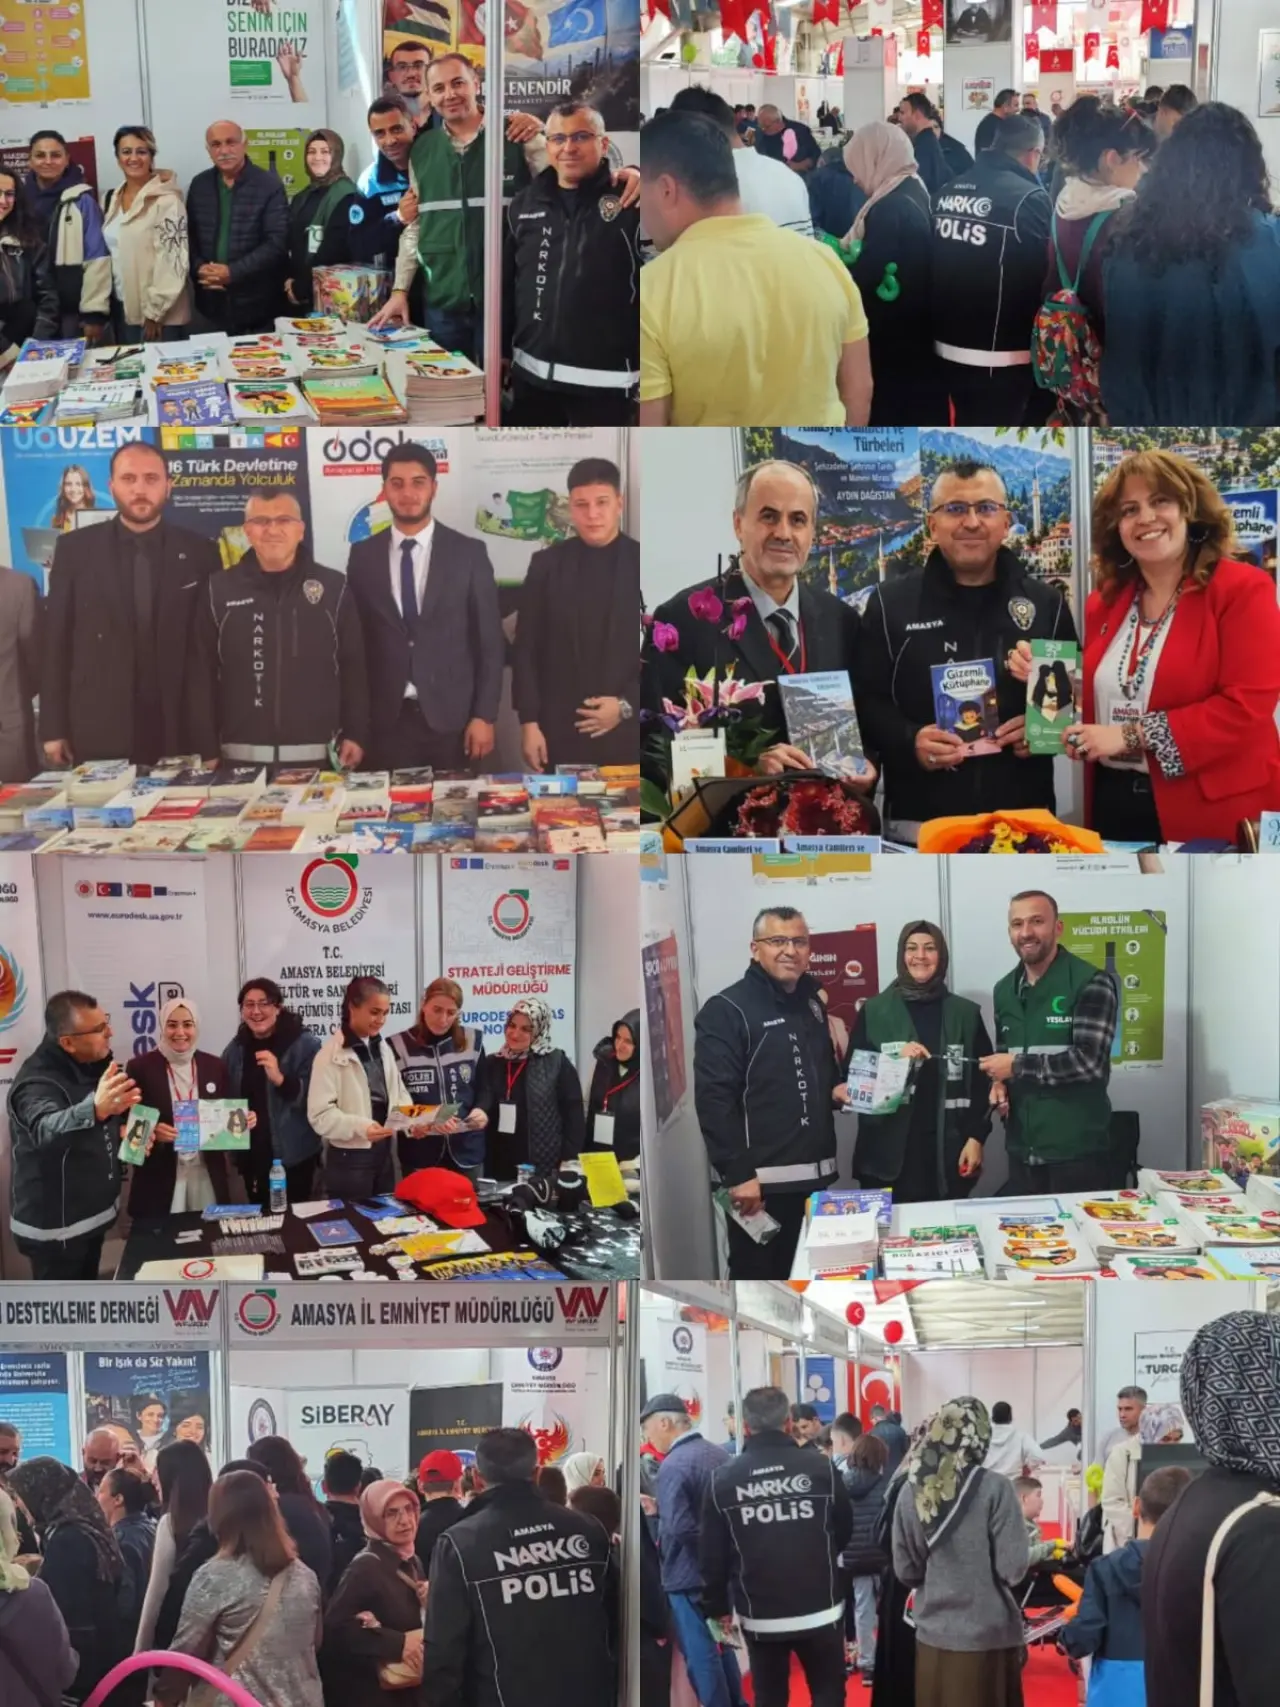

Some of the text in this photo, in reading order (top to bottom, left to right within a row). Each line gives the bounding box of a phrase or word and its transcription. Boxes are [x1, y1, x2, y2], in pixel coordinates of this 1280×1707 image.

[853, 436, 905, 453] Türbeleri
[186, 459, 220, 473] Türk
[223, 458, 298, 472] Devletine
[171, 473, 296, 487] Zamanda Yolculuk
[280, 961, 385, 979] AMASYA BELEDİYESİ
[447, 960, 572, 979] STRATEJİ GELİŞTİRME
[312, 989, 324, 998] ve
[472, 980, 549, 996] MÜDÜRLÜĞÜ
[6, 1295, 160, 1325] DESTEKLEME DERNEĞİ
[290, 1302, 357, 1326] AMASYA
[361, 1297, 376, 1325] İL
[380, 1297, 451, 1325] EMNİYET
[455, 1295, 554, 1324] MÜDÜRLÜĞÜ
[135, 1356, 148, 1368] da
